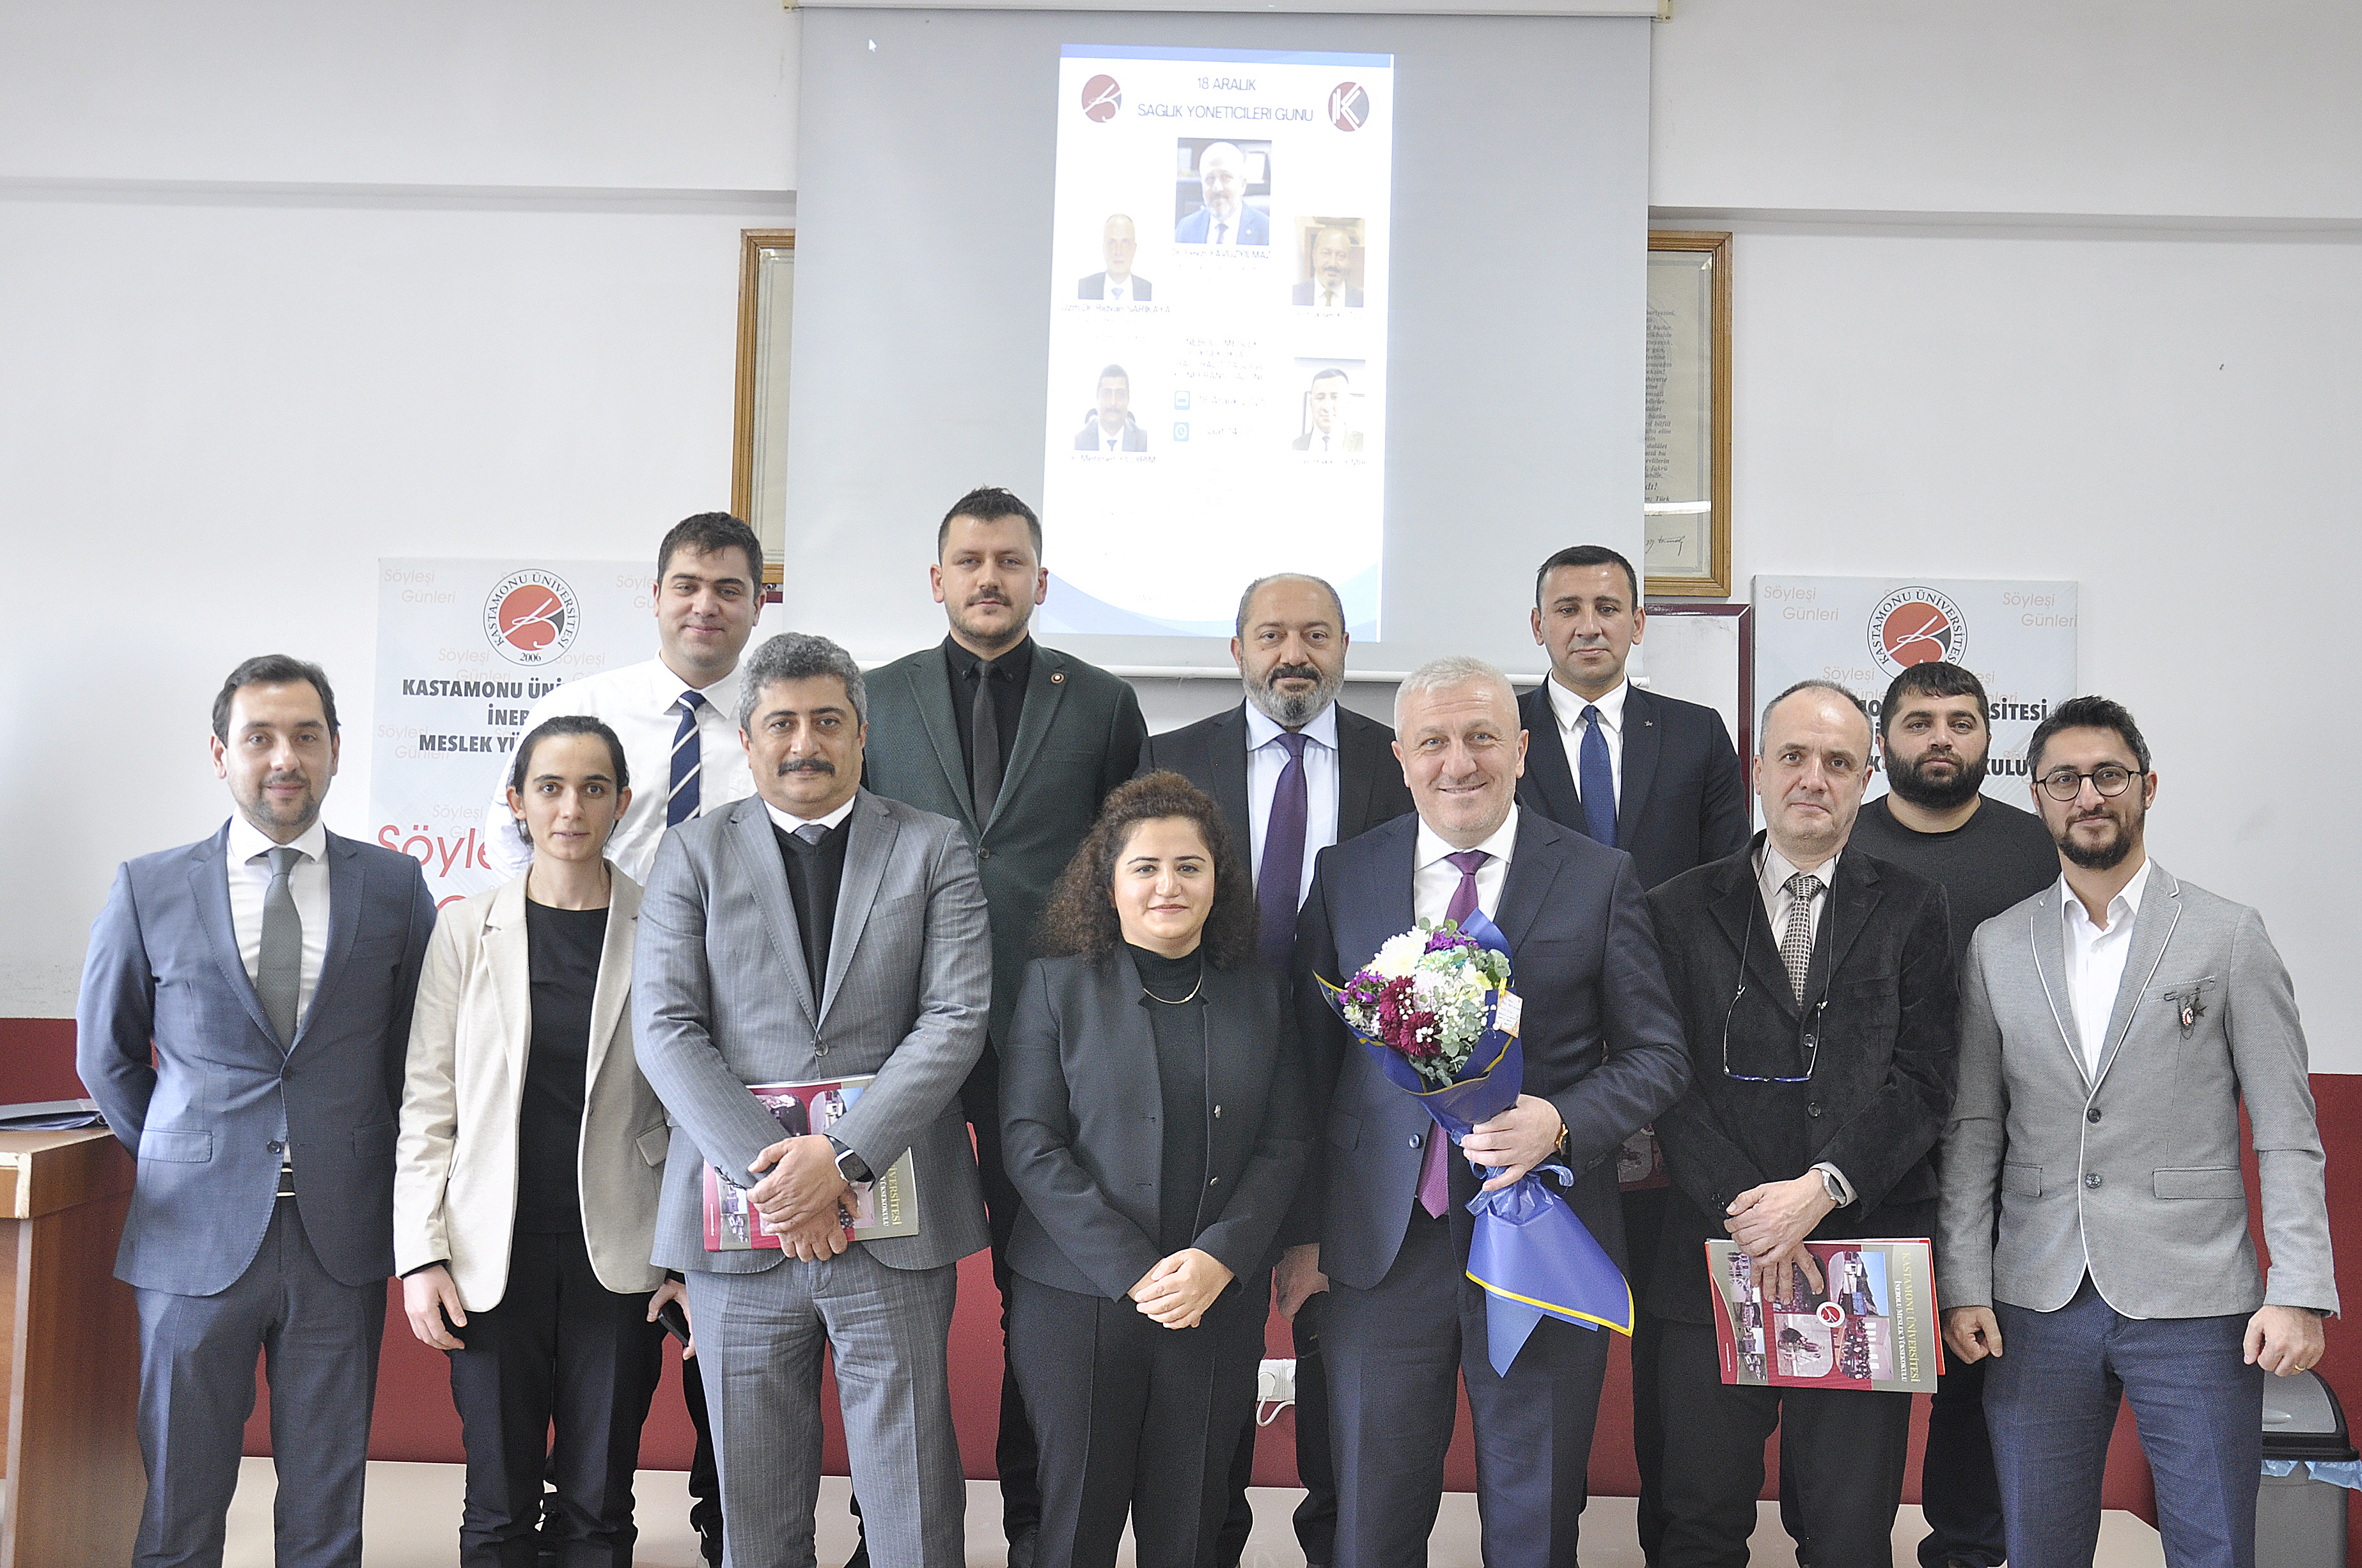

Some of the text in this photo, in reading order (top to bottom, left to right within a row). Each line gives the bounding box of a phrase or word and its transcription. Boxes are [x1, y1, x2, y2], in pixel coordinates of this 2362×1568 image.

[1197, 77, 1256, 91] 18 ARALIK
[384, 568, 435, 586] Söyleşi
[401, 589, 457, 603] Günleri
[1764, 586, 1817, 602] Söyleşi
[2002, 592, 2055, 609] Söyleşi
[487, 574, 528, 647] KASTAMONU
[1782, 607, 1840, 621] Günleri
[1872, 589, 1965, 665] KASTAMONU ÜNİVERSİTES
[2021, 613, 2077, 628] Günleri
[437, 648, 490, 665] Söyleşi
[519, 652, 542, 662] 2006
[1822, 666, 1875, 683] Söyleşi
[402, 679, 523, 699] KASTAMONU
[419, 734, 492, 752] MESLEK
[888, 1166, 903, 1226] İVERSİTESİ
[1902, 1252, 1915, 1314] KASTAMONU
